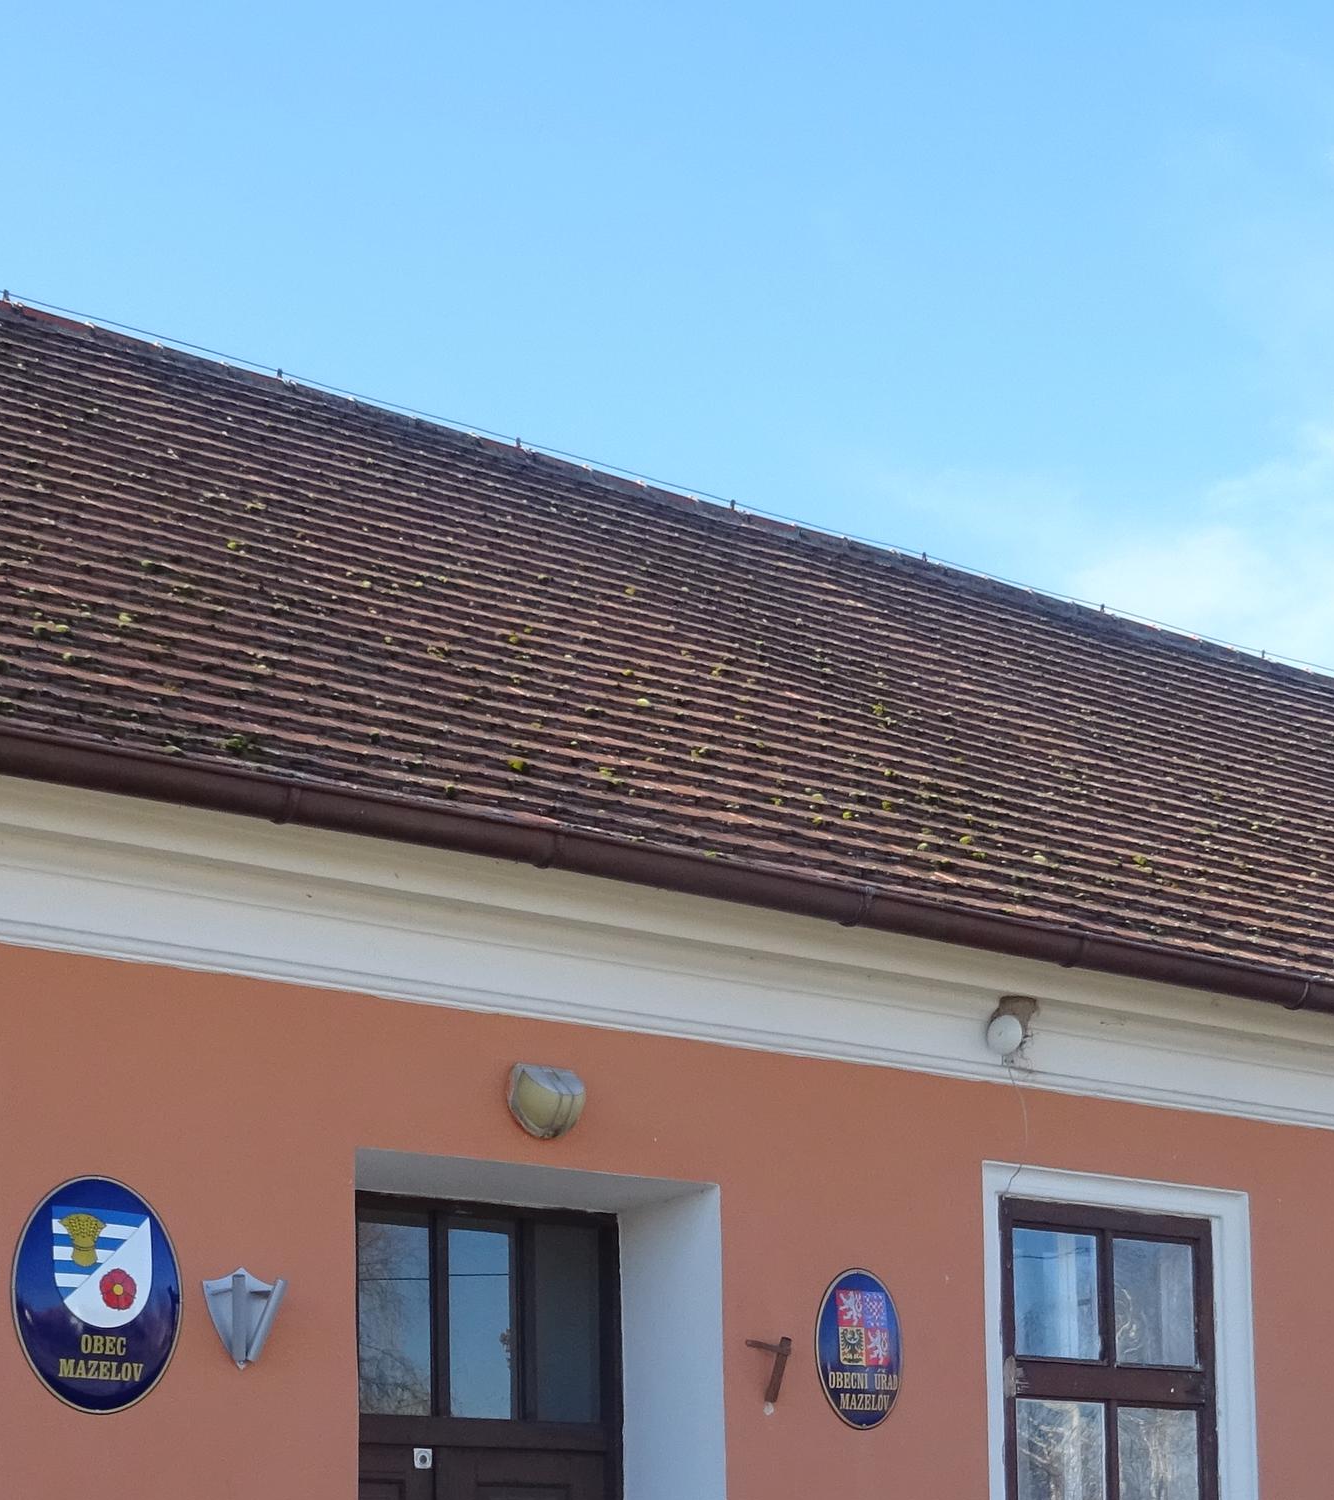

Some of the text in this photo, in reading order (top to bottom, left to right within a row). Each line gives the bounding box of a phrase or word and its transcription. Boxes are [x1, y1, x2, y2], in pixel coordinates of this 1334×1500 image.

[80, 1334, 127, 1356] OBEC
[58, 1358, 144, 1382] MAZELOV
[828, 1367, 899, 1391] OBECNÍ ÚŘAD
[839, 1393, 890, 1411] MAZELOV
